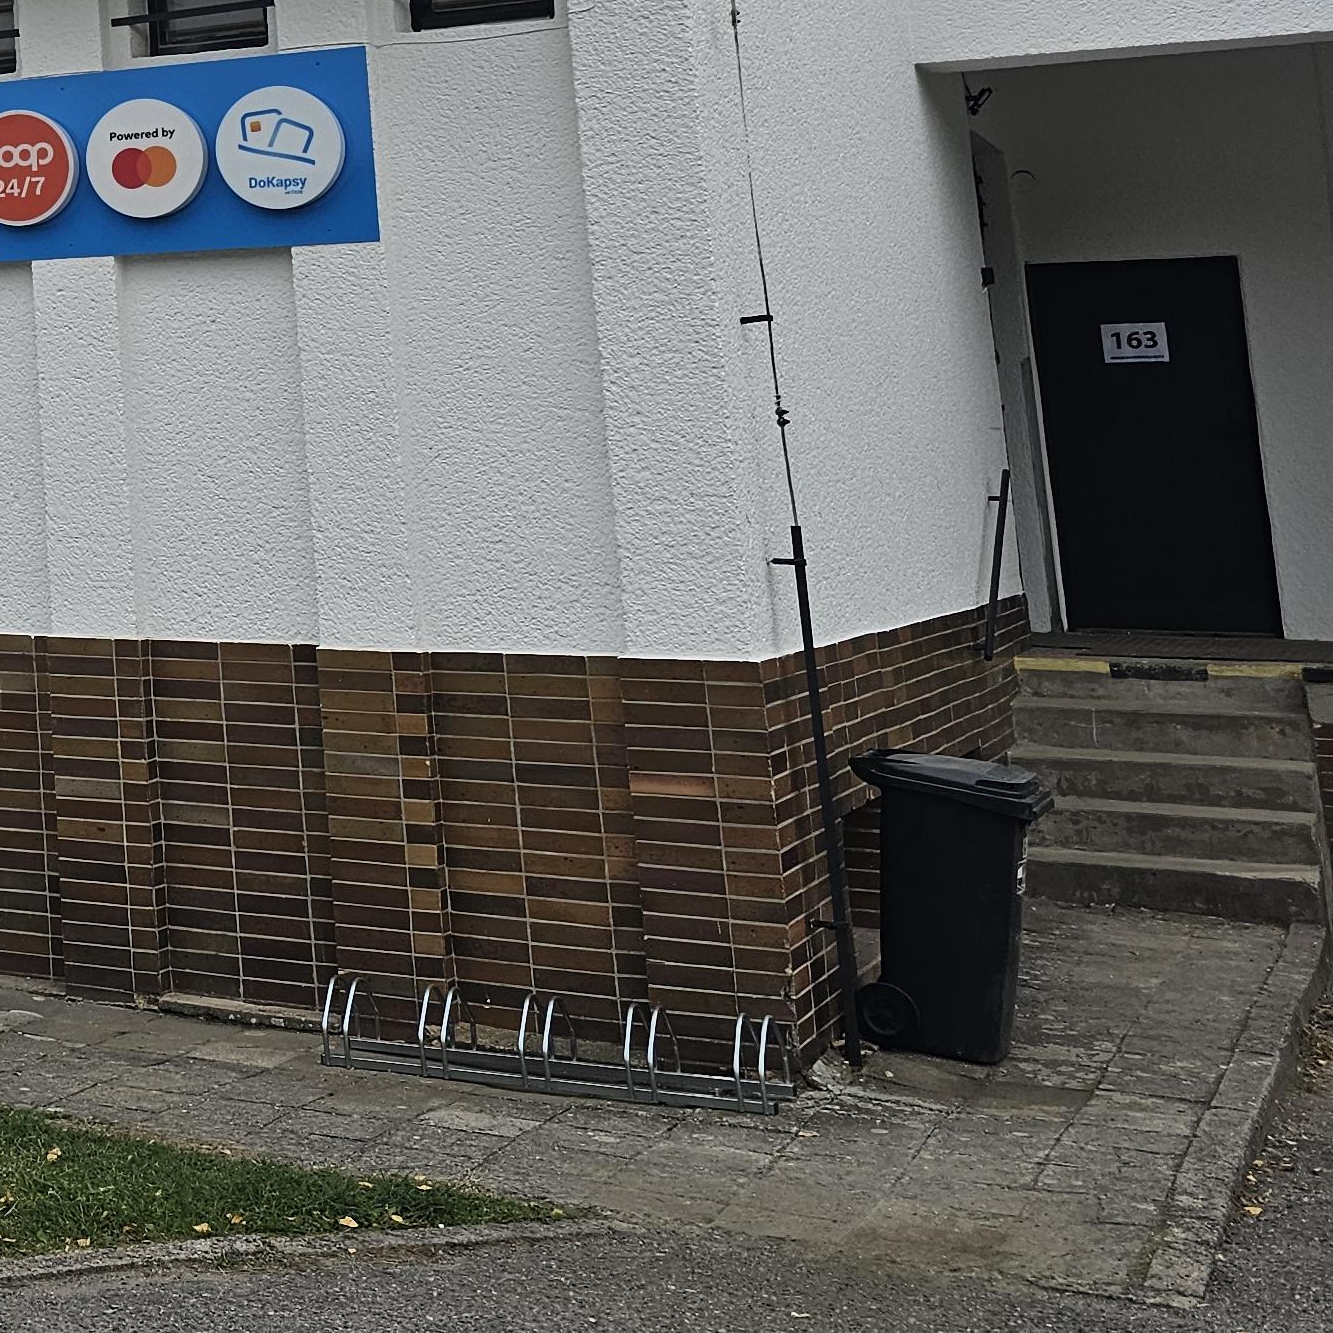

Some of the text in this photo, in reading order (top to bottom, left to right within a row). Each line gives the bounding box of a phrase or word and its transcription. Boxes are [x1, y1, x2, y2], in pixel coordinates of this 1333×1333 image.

[109, 127, 176, 142] Powered by
[248, 176, 307, 190] DoKapsy
[1110, 330, 1159, 350] 163
